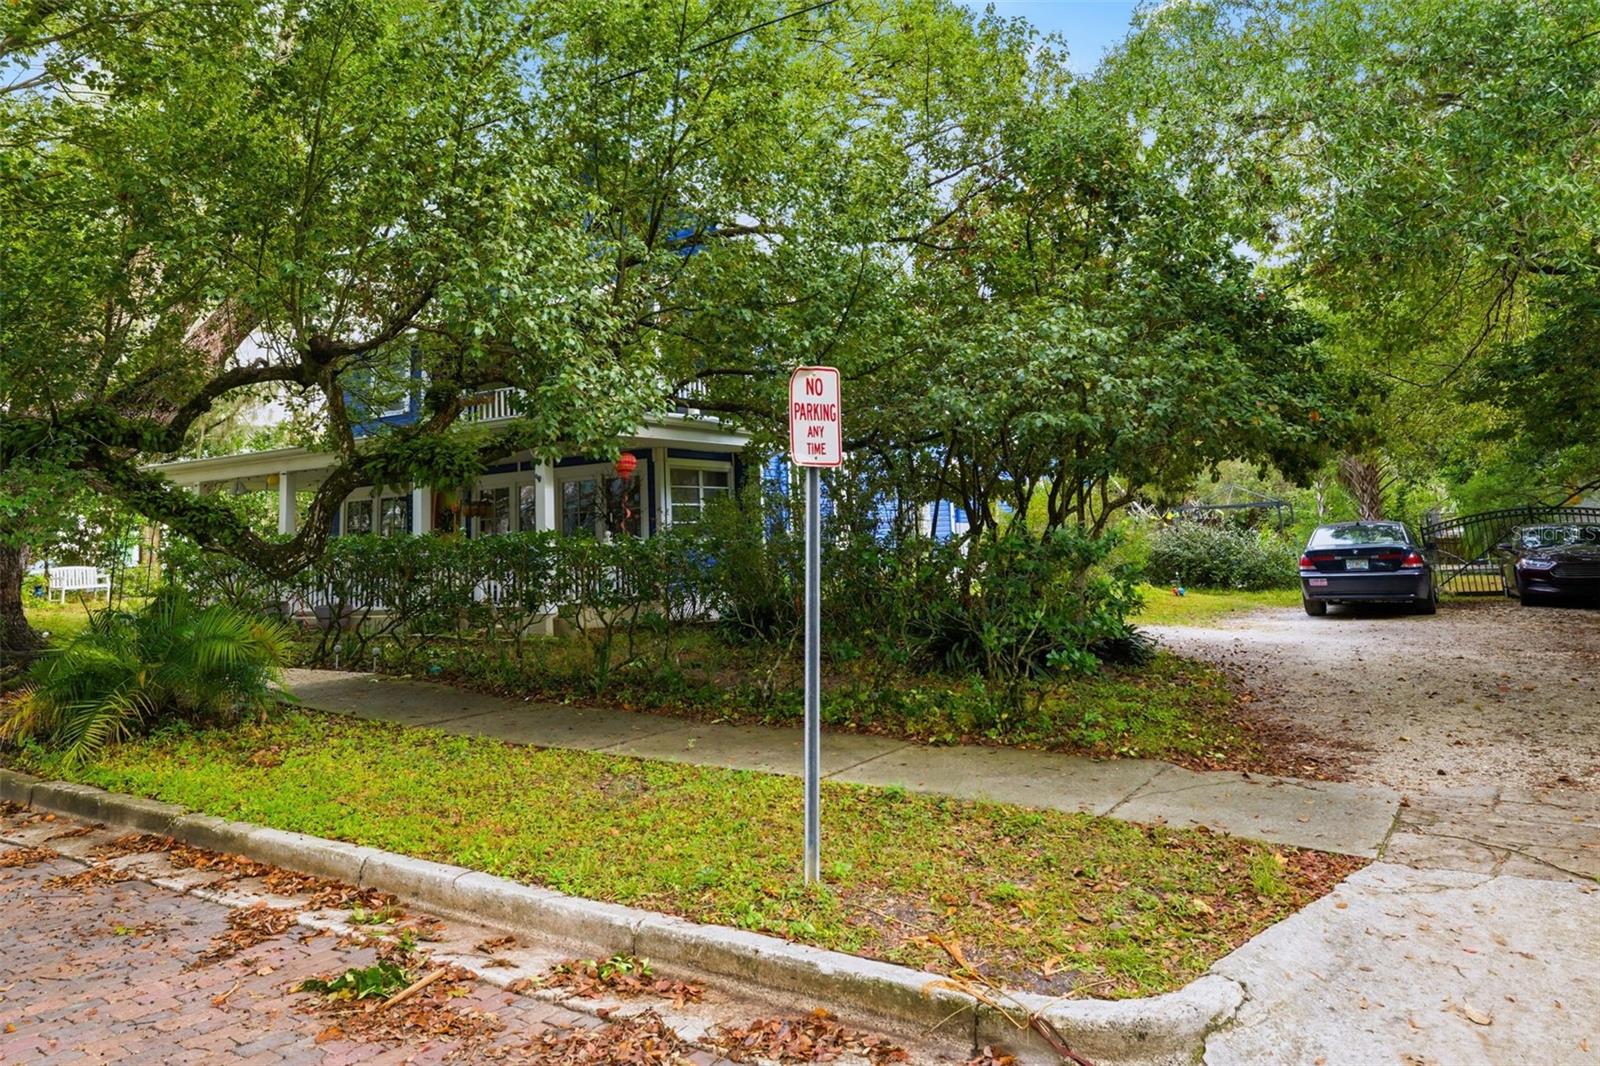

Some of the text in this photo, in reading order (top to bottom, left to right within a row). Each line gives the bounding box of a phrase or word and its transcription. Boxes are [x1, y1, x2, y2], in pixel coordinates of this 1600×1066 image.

[806, 378, 823, 396] NO
[794, 402, 836, 422] PARKING
[807, 425, 824, 438] ANY
[807, 443, 826, 455] TIME
